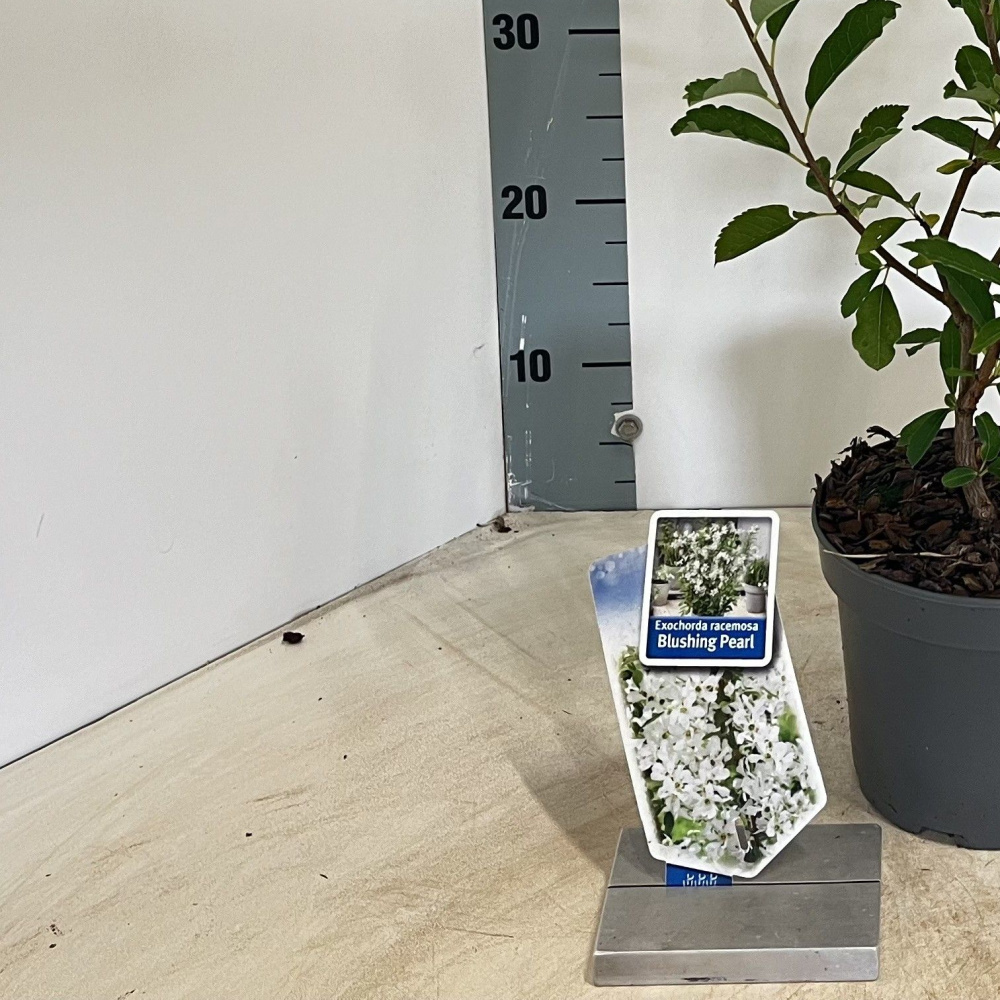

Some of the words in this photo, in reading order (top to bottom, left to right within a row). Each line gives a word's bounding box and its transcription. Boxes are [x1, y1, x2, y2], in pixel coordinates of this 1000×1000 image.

[491, 12, 540, 51] 30
[500, 184, 548, 220] 20
[509, 348, 552, 383] 10
[655, 620, 708, 631] Exochorda
[710, 622, 759, 631] racemosa
[657, 633, 718, 652] Blushing
[720, 633, 755, 649] Pearl
